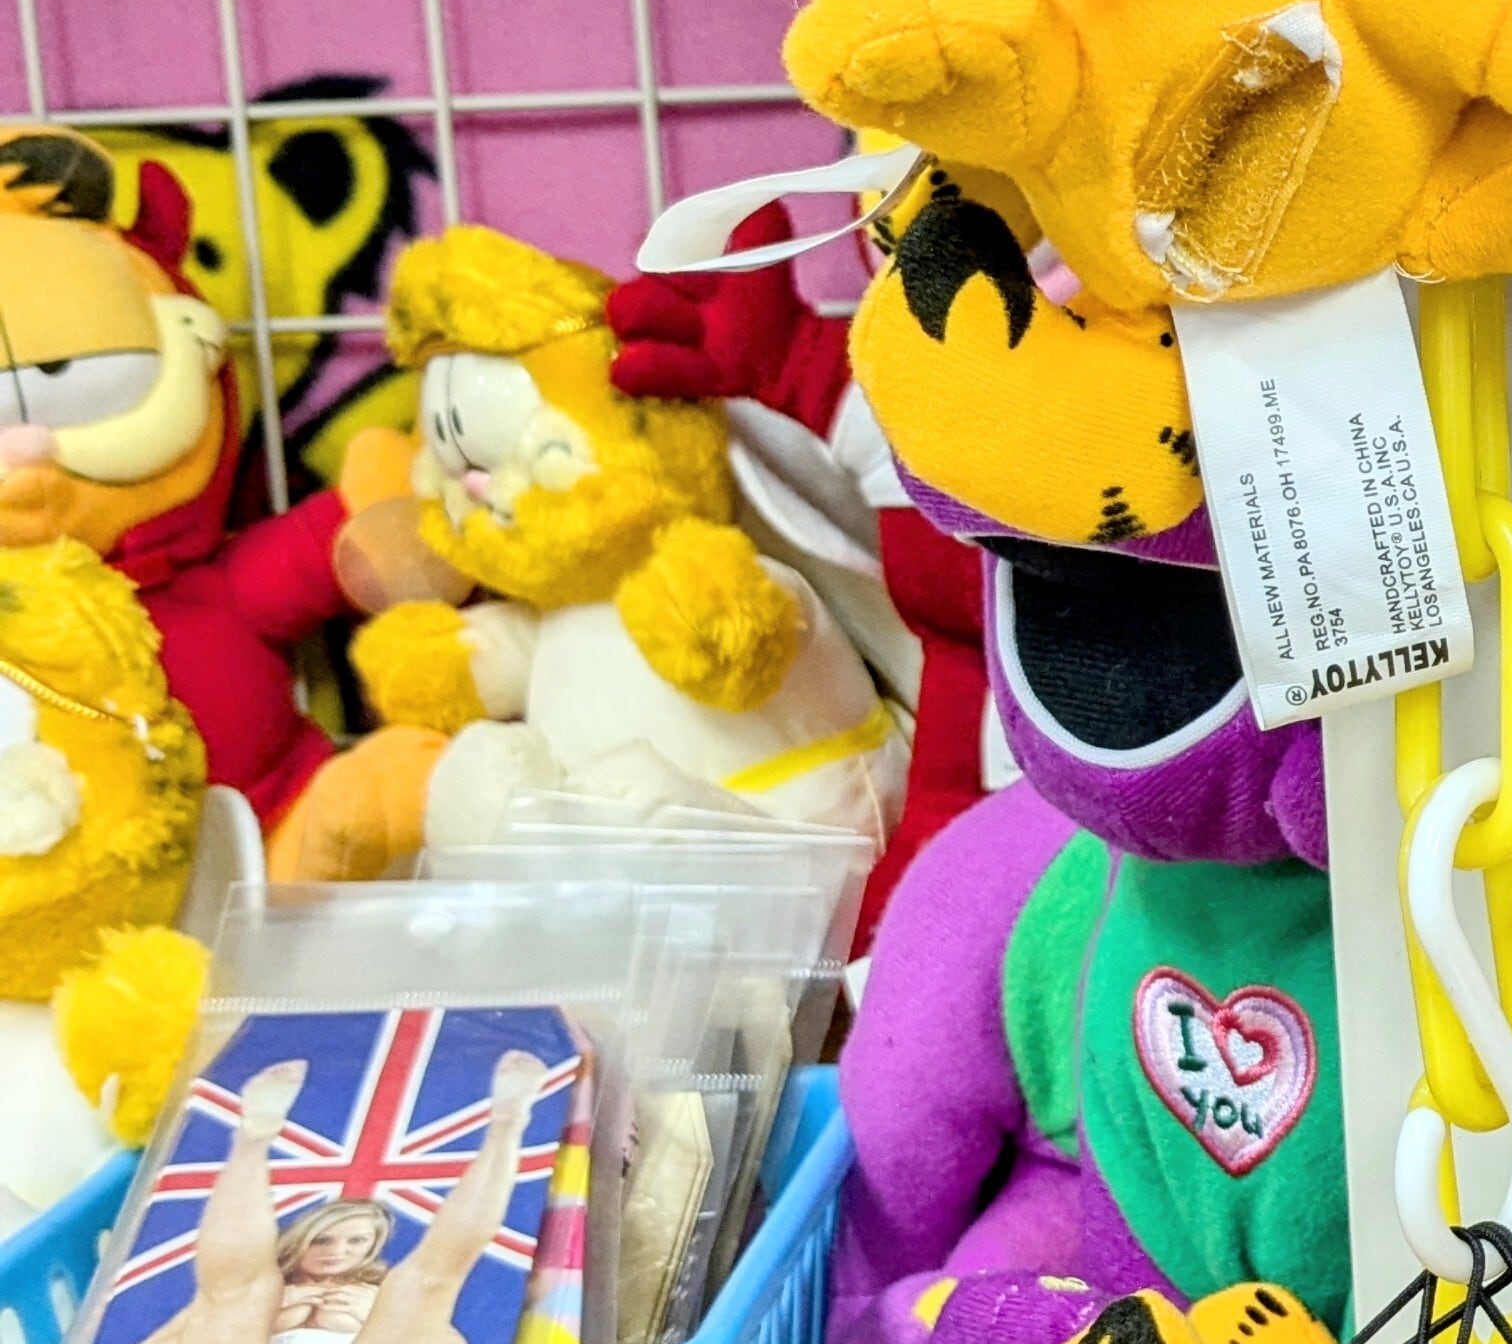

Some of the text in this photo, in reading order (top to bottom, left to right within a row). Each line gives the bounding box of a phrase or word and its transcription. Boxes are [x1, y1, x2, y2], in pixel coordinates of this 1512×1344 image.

[1260, 378, 1291, 468] 17499.ME
[1349, 412, 1407, 634] HANDCRAFTED IN CHINA
[1240, 472, 1295, 660] ALL NEW MATERIALS
[1328, 607, 1349, 648] 3754
[1424, 593, 1443, 627] LOS
[1168, 1002, 1207, 1072] I
